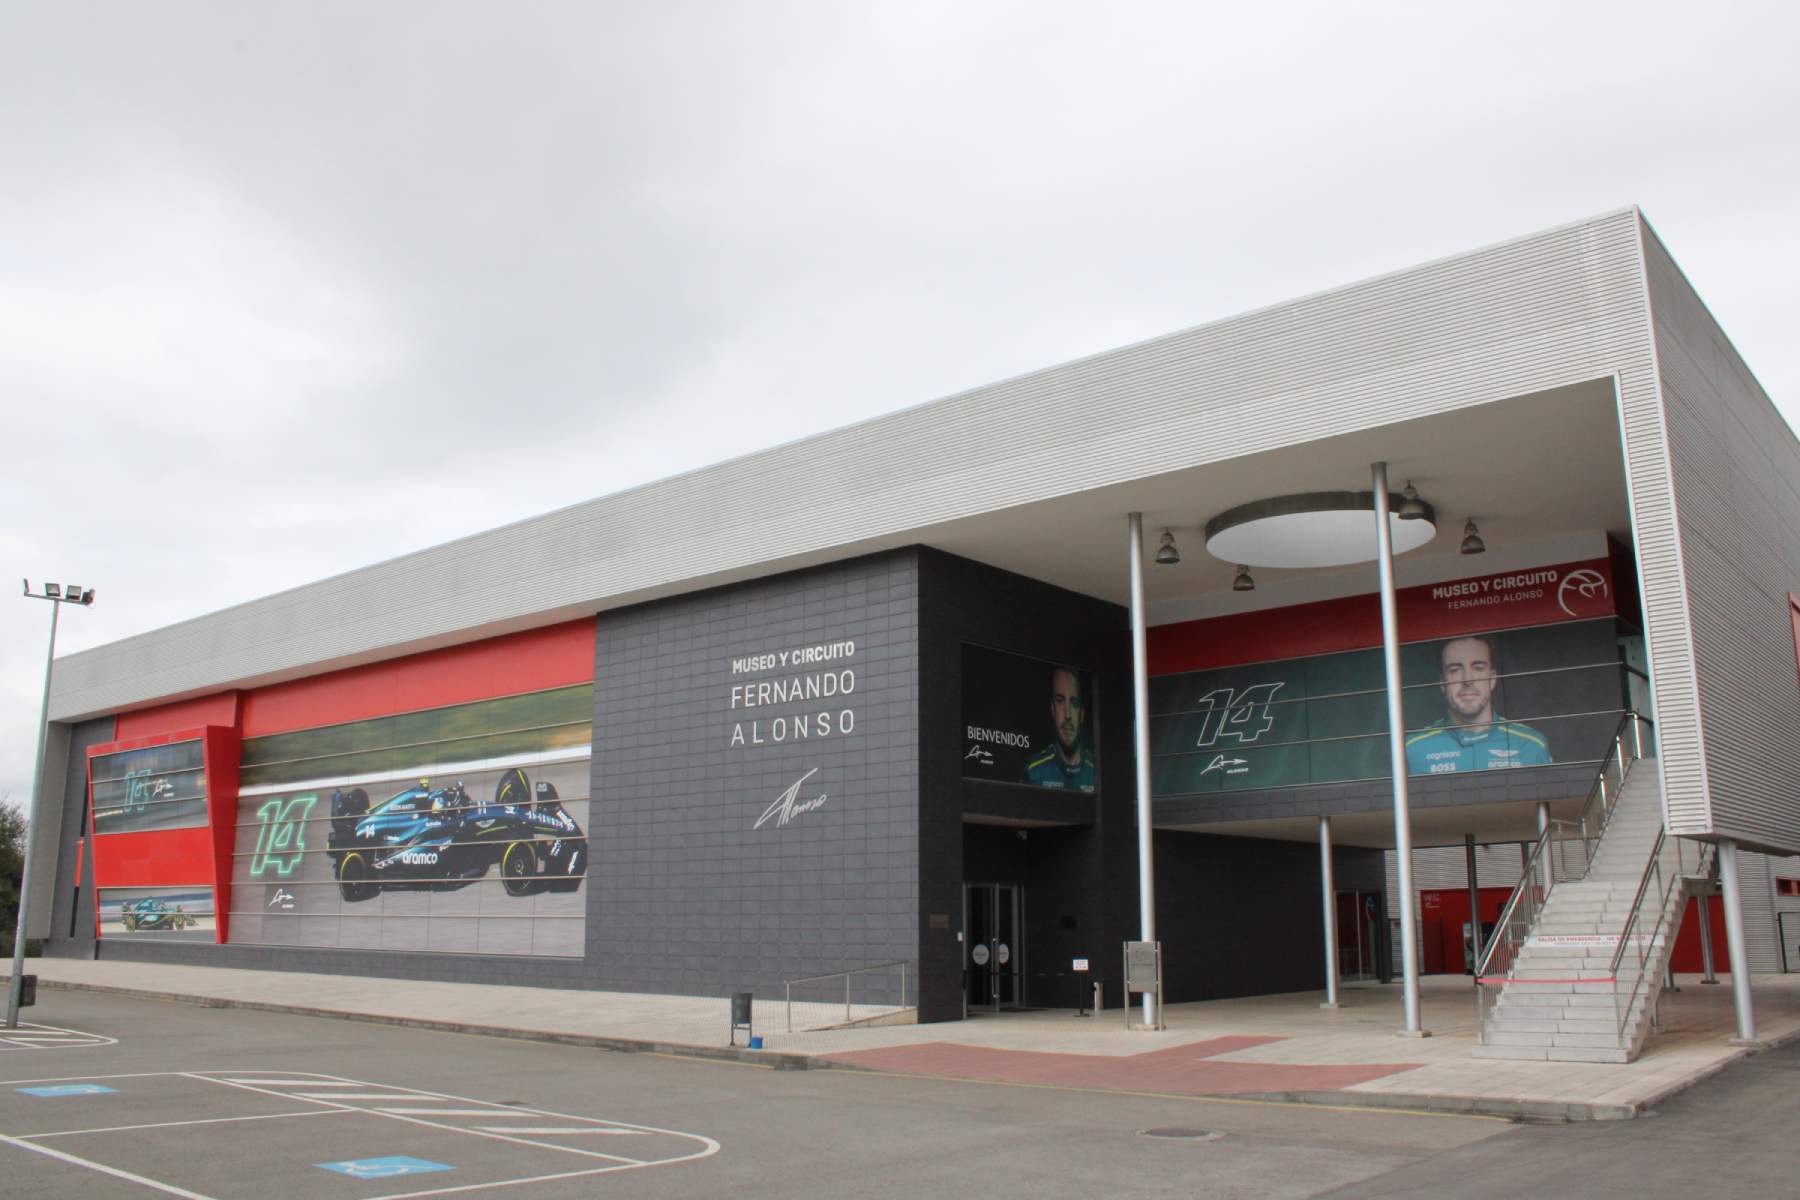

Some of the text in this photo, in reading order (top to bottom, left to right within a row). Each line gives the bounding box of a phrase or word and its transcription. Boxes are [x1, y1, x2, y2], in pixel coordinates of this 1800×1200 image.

[1433, 570, 1558, 599] MUSEO Y CIRCUITO
[1448, 589, 1544, 610] FERNANDO ALONSO
[732, 641, 855, 674] MUSEO Y CIRCUITO
[731, 670, 855, 709] FERNANDO
[731, 709, 854, 746] ALONSO
[1197, 682, 1285, 746] 14
[967, 725, 1030, 748] BIENVENIDOS
[250, 792, 317, 876] 14
[402, 852, 438, 865] aramco
